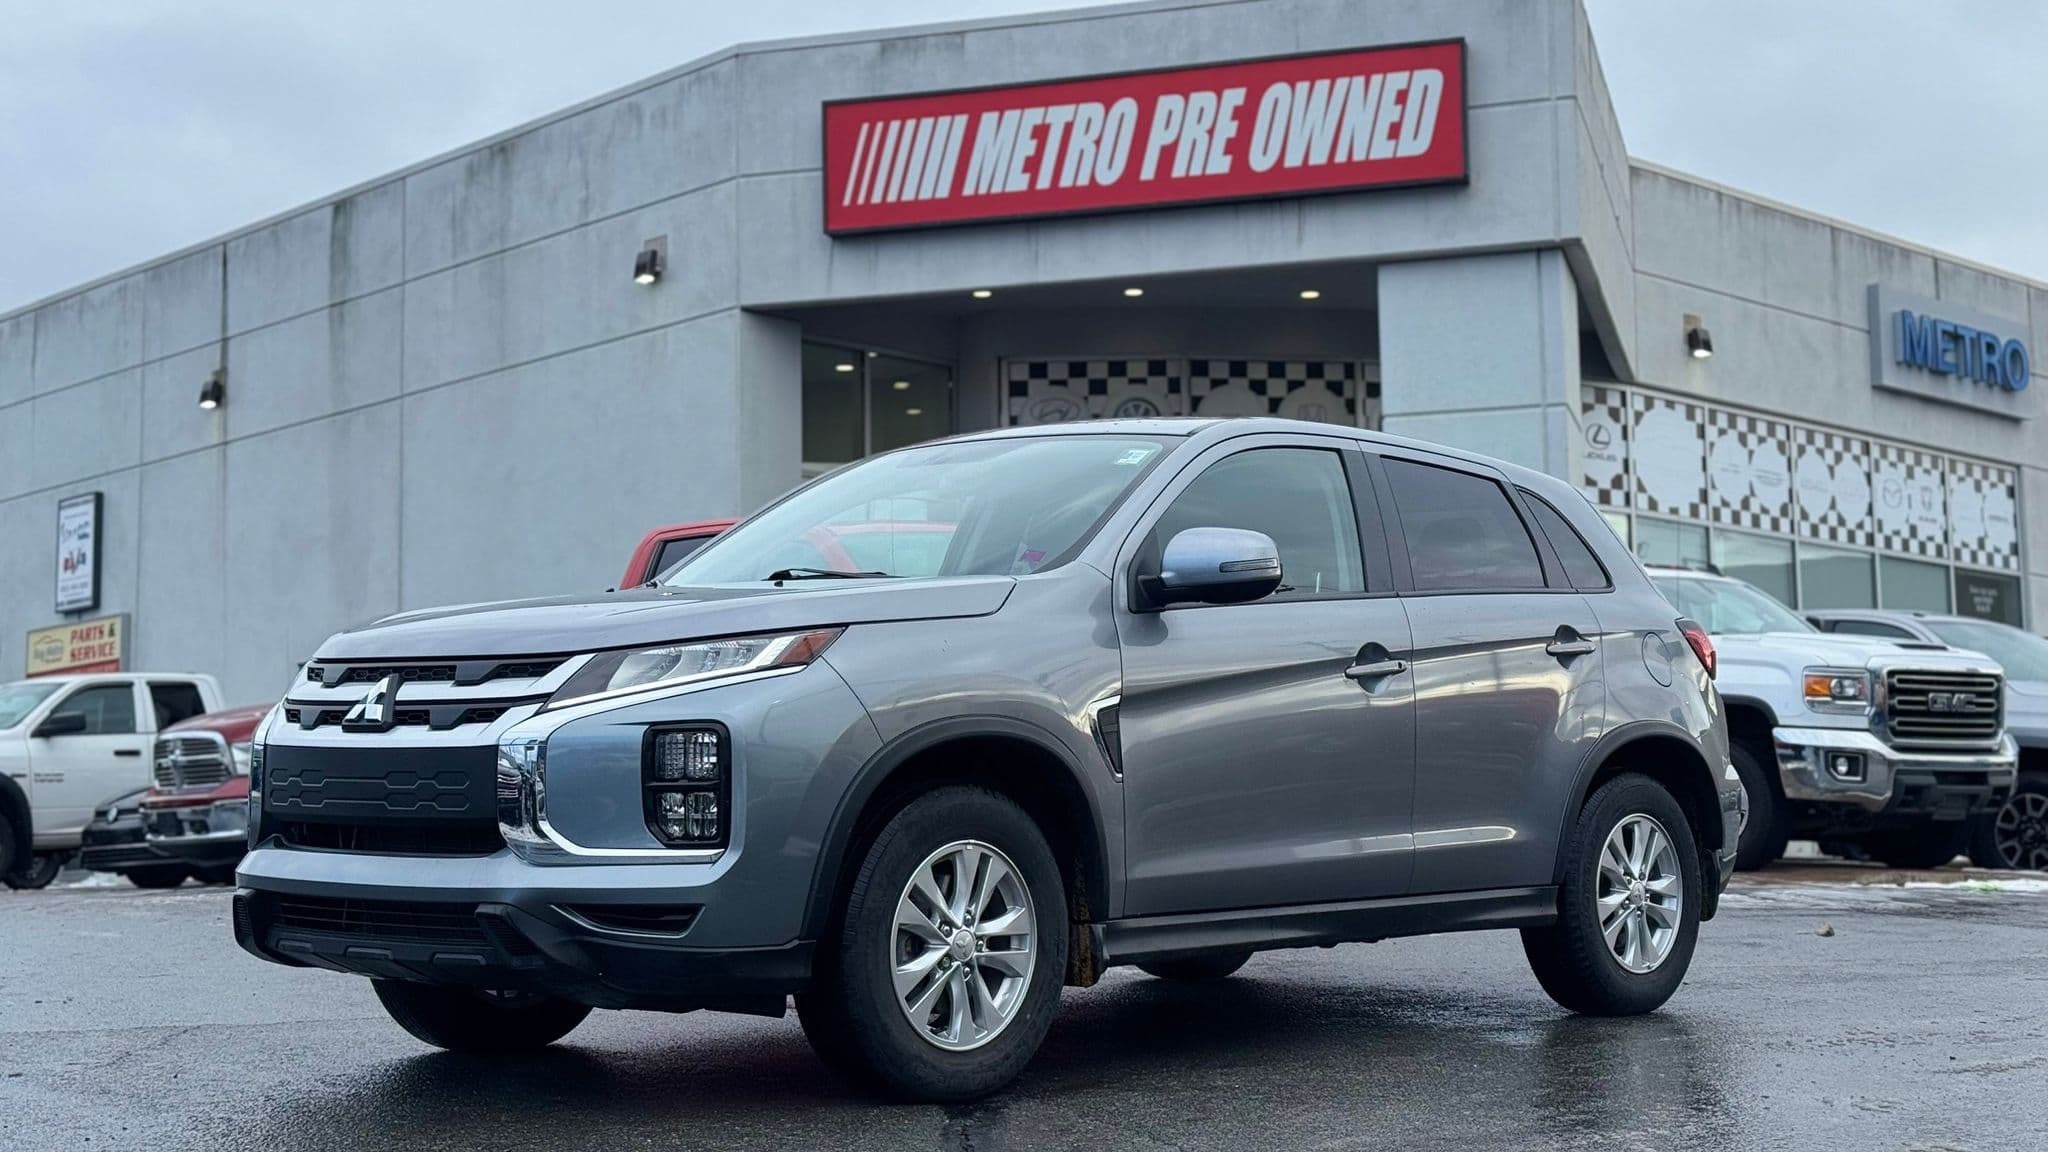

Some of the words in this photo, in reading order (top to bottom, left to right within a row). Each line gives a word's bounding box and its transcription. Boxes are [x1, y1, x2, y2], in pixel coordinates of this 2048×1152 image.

[962, 97, 1138, 197] METRO
[1140, 87, 1246, 181] PRE
[1248, 68, 1444, 174] OWNED
[1896, 310, 2029, 391] METRO
[70, 624, 104, 644] PARTS
[69, 641, 116, 663] SERVICE
[1928, 692, 1977, 712] GMC
